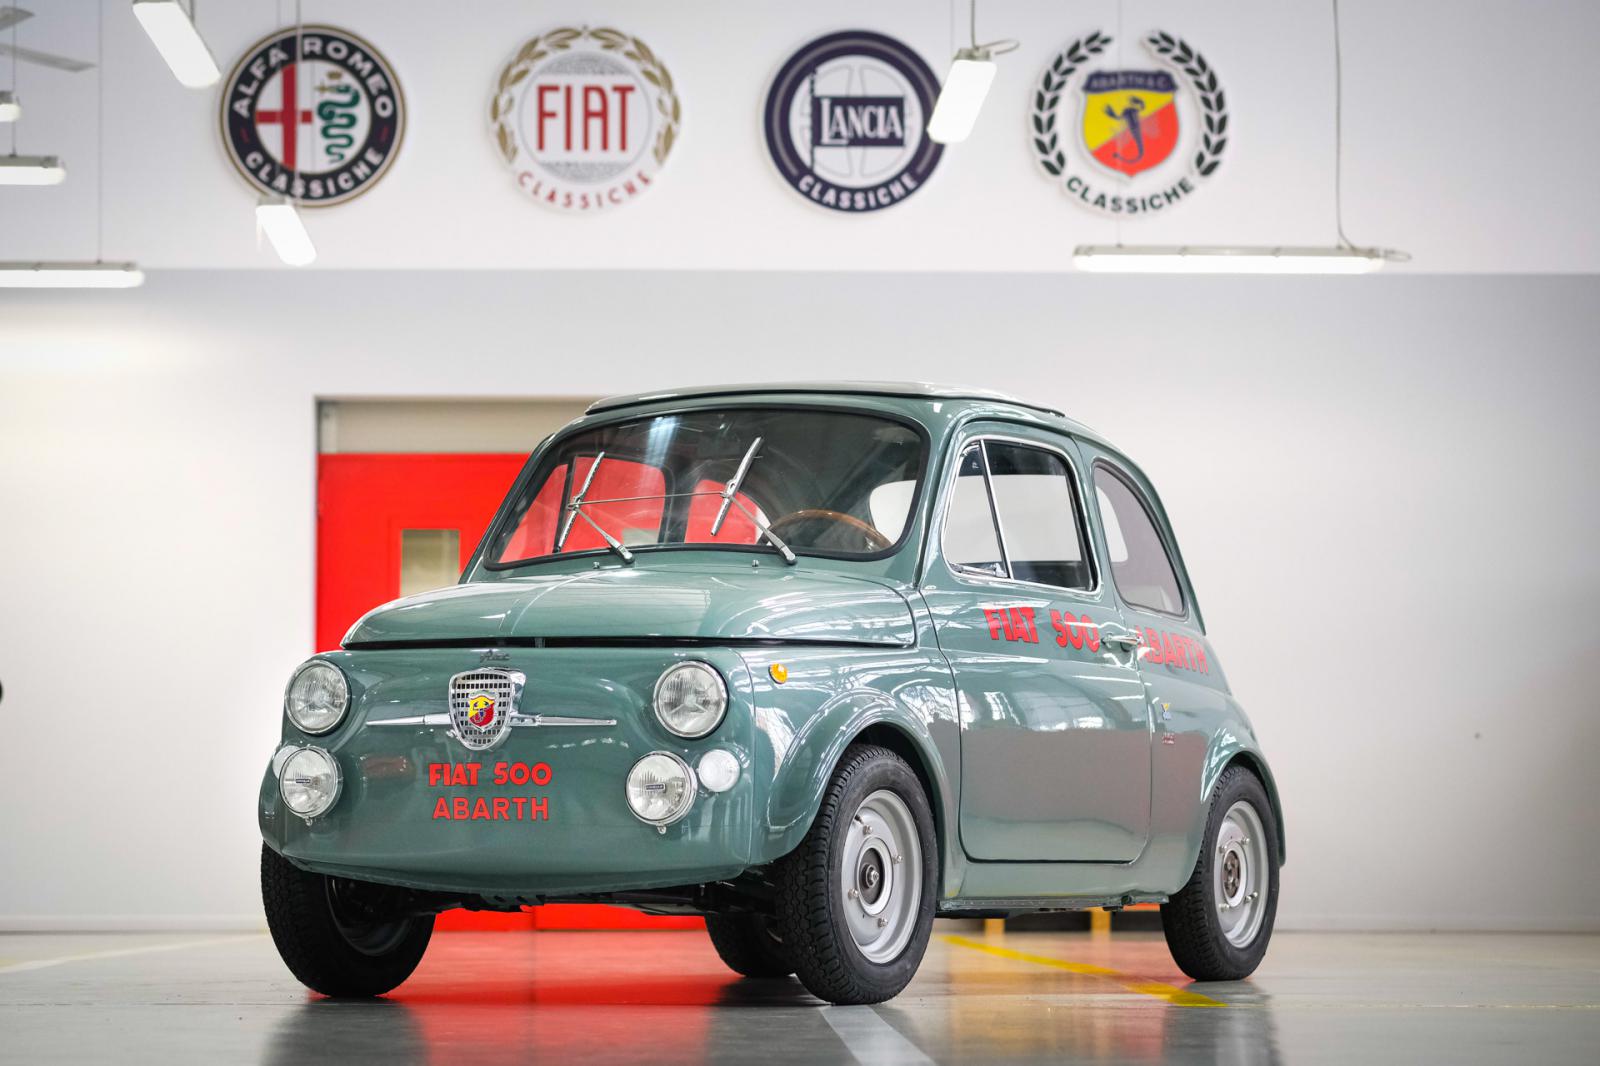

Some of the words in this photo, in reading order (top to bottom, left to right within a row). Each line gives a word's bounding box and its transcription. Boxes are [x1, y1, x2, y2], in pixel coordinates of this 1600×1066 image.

[234, 47, 287, 118] ALFA
[303, 36, 394, 118] ROMEO
[536, 84, 635, 151] FIAT
[821, 97, 902, 145] LANCIA
[245, 149, 384, 197] CLASSICHE
[518, 170, 652, 209] CLASSICHE
[798, 171, 918, 209] CLASSICHE
[1066, 176, 1194, 213] CLASSICHE
[984, 606, 1040, 643] FIAT
[1050, 608, 1100, 653] 500
[428, 762, 482, 786] FIAT
[493, 761, 552, 786] 500
[432, 796, 549, 820] ABARTH
